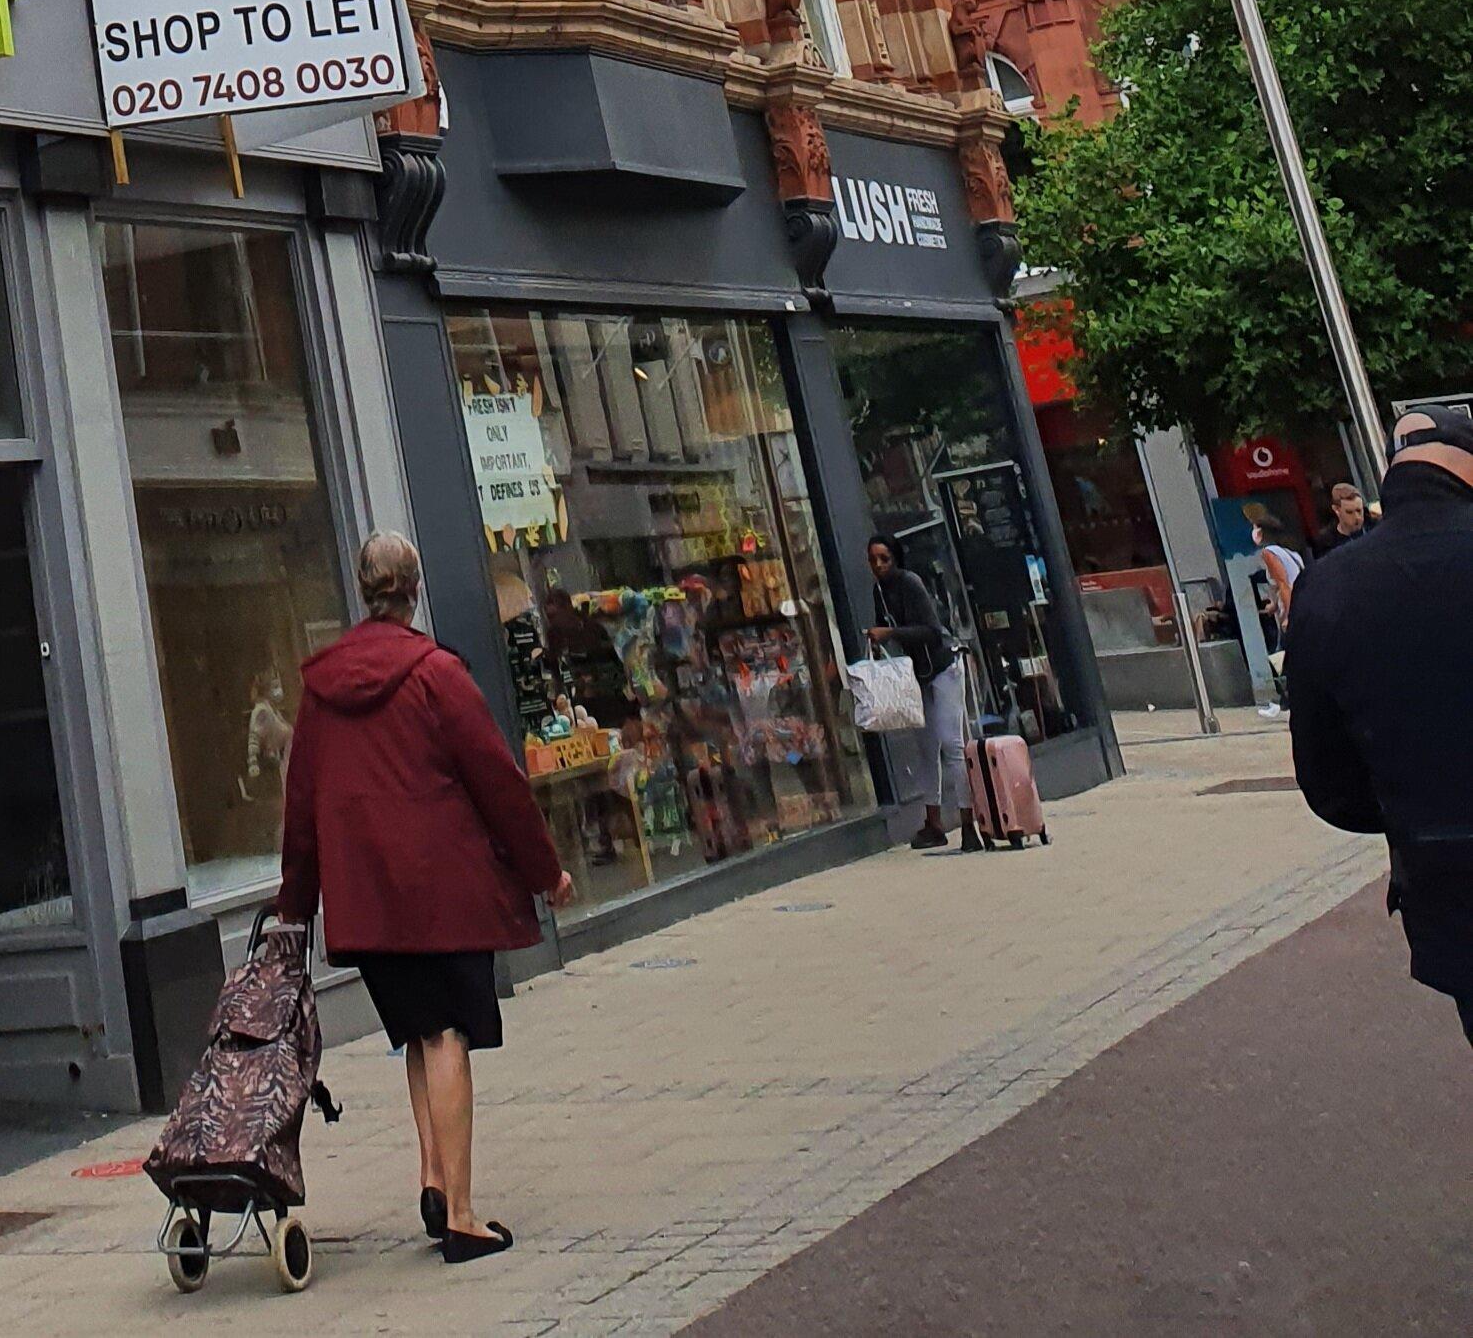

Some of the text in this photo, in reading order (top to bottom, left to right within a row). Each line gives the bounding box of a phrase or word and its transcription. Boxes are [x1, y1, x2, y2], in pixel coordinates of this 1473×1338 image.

[103, 10, 221, 63] SHOP
[232, 2, 291, 46] TO
[111, 53, 395, 117] 020 7408 0030
[830, 175, 915, 246] LUSH
[904, 187, 939, 215] FRESH
[486, 424, 509, 442] ONLY
[489, 480, 524, 502] DEFINES
[529, 479, 541, 497] US
